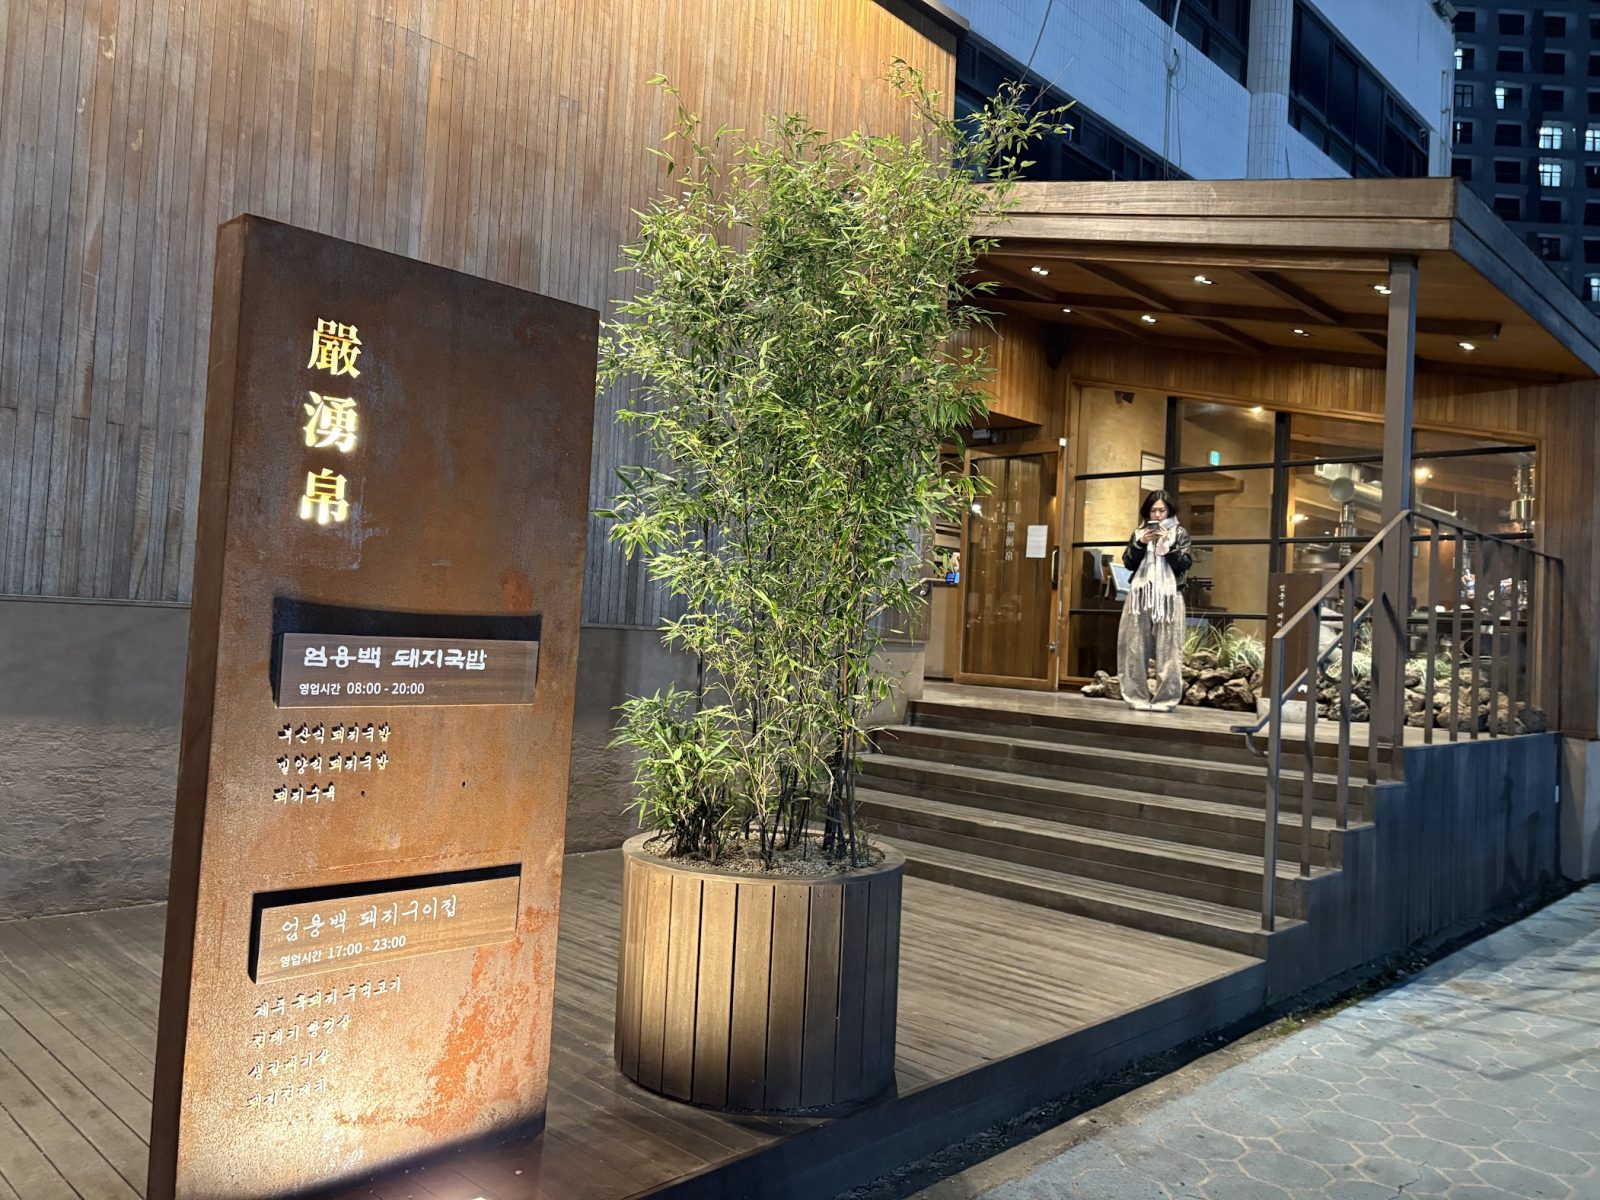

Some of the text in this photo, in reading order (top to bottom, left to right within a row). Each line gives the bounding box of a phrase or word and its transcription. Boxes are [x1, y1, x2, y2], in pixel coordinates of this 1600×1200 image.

[298, 317, 363, 525] 嚴湧帛
[303, 645, 488, 671] 엄용백 돼지국밥
[299, 683, 341, 696] 영업시간
[347, 682, 381, 695] 08:00
[391, 682, 425, 695] 20:00
[278, 724, 392, 745] 부산식 돼지국밥
[277, 753, 389, 776] 밀양식 돼지국밥
[273, 785, 336, 805] 돼지수육
[282, 895, 457, 943] 엄용백 돼지구이집
[280, 950, 323, 968] 영업시간
[328, 941, 363, 960] 17:00
[372, 935, 406, 953] 23:00
[253, 996, 286, 1019] 제주
